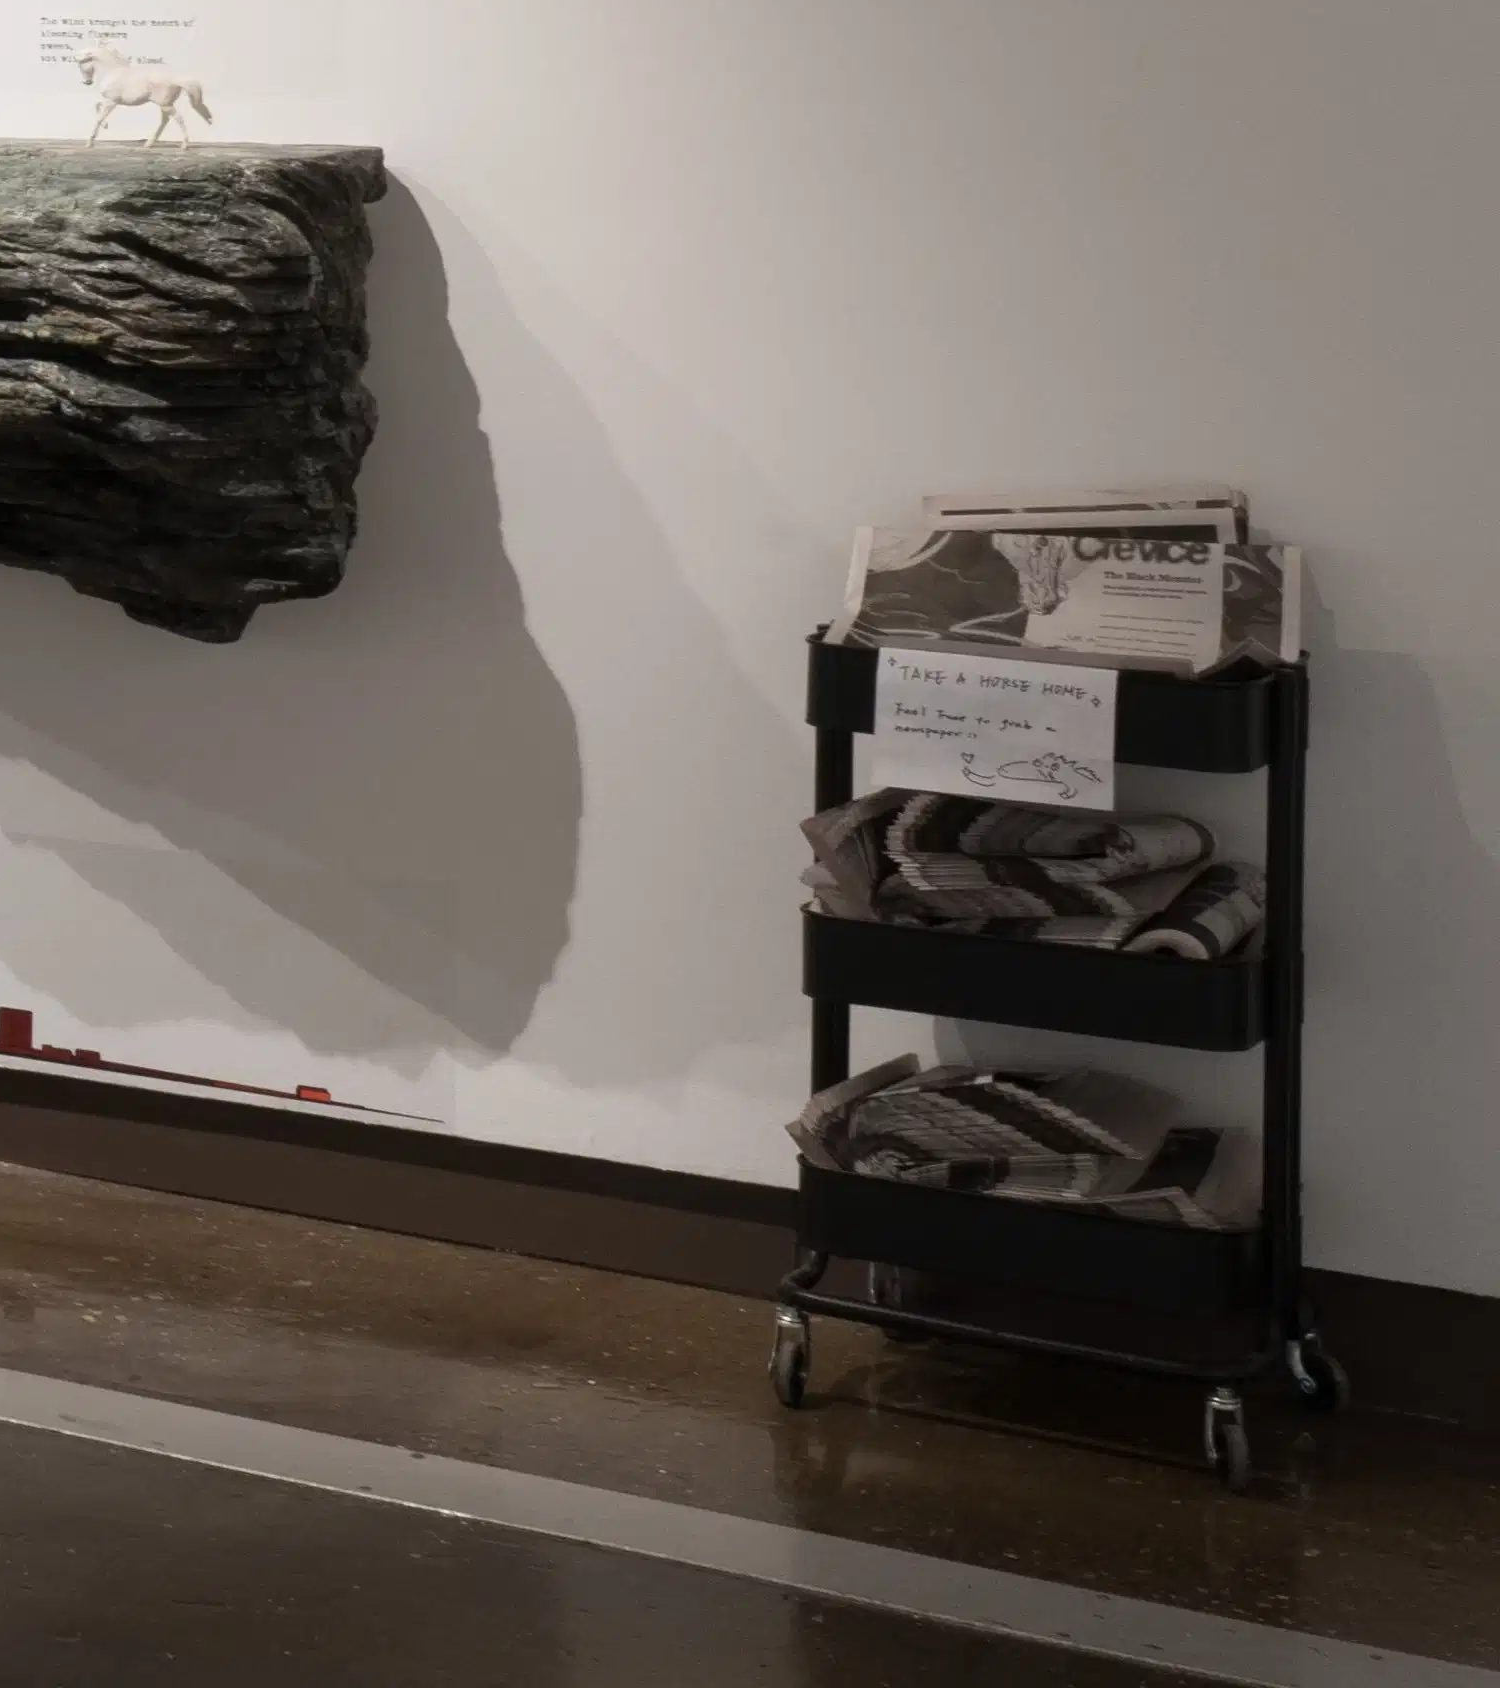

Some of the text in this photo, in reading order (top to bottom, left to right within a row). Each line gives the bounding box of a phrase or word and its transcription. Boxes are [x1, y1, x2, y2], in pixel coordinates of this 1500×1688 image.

[1073, 537, 1210, 566] Crevice
[900, 665, 1088, 700] TAKE A HORSE HOME
